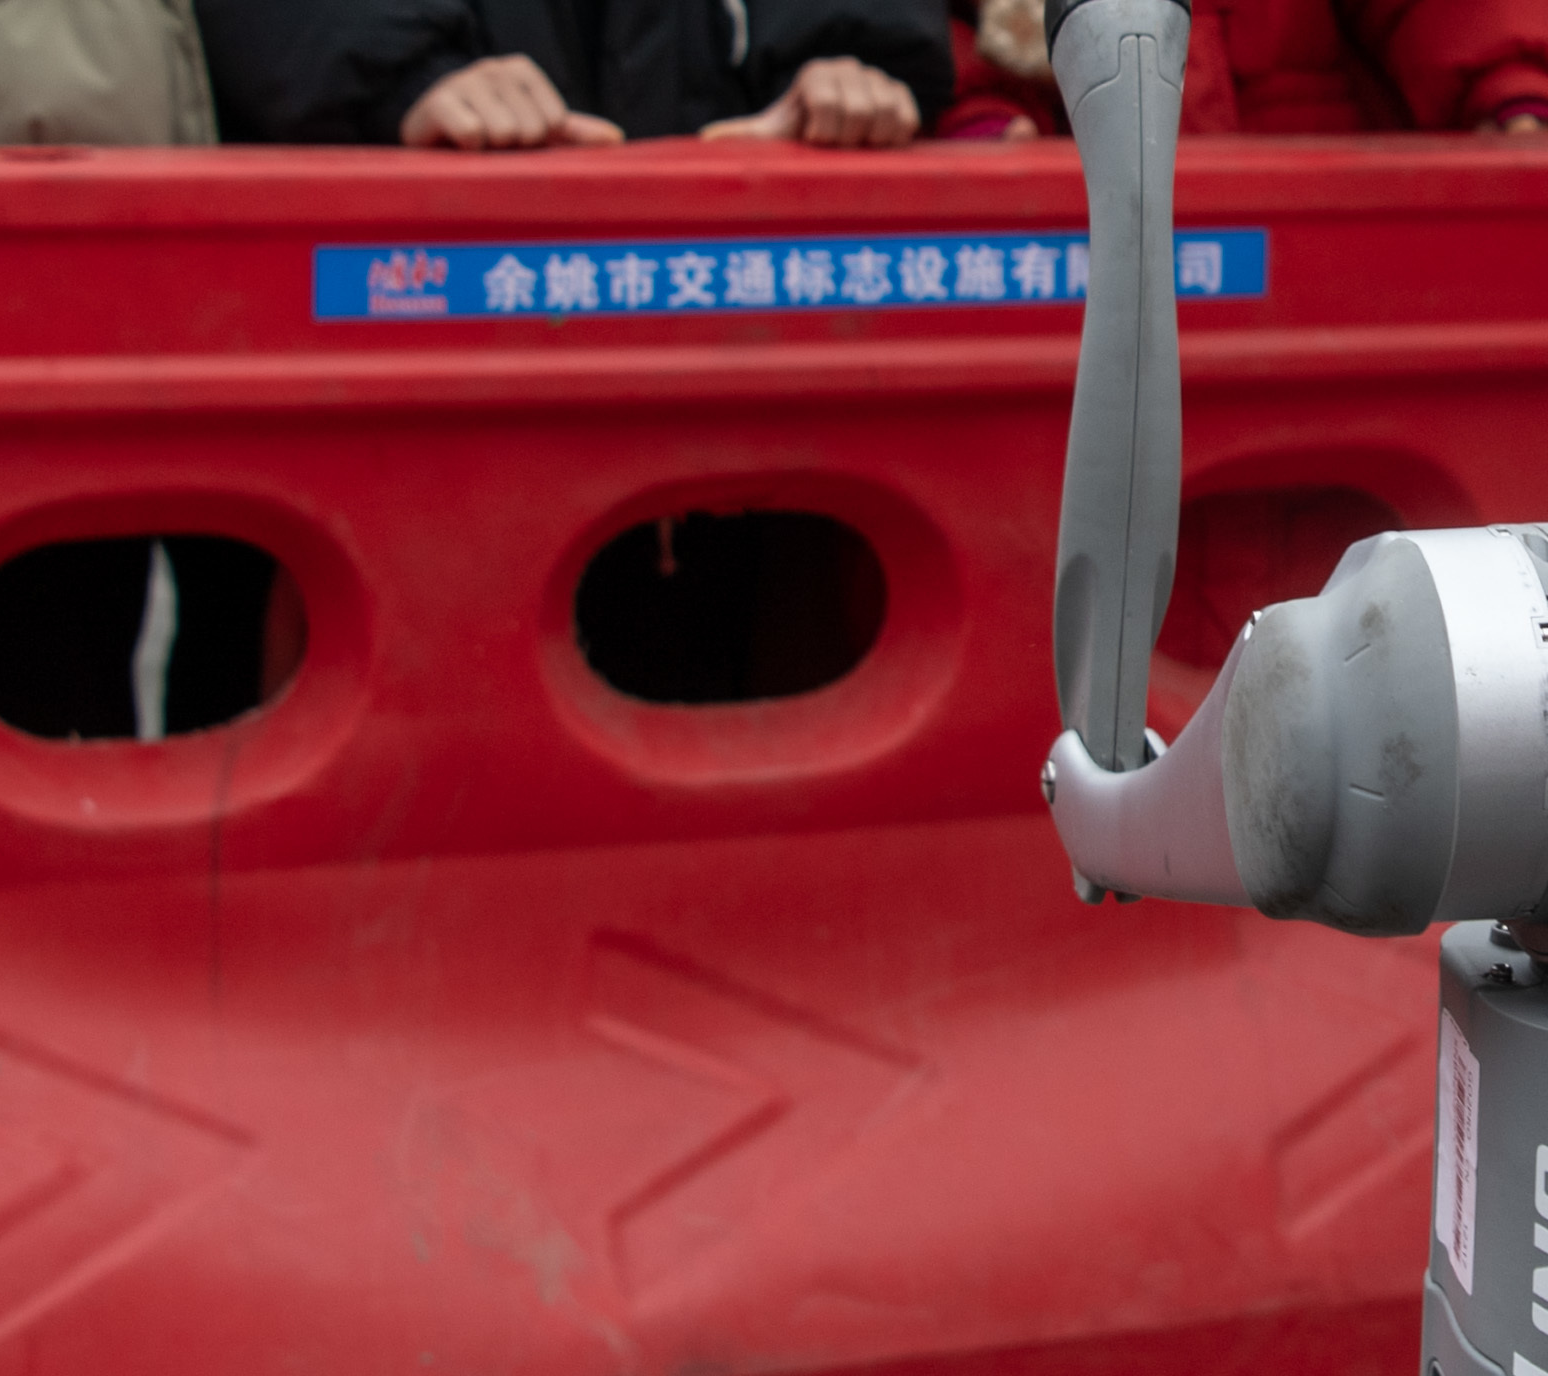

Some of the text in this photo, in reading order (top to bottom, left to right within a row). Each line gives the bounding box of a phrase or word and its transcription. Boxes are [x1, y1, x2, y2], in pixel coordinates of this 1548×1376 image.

[483, 240, 1224, 312] 余姚市交通标志设施有司
